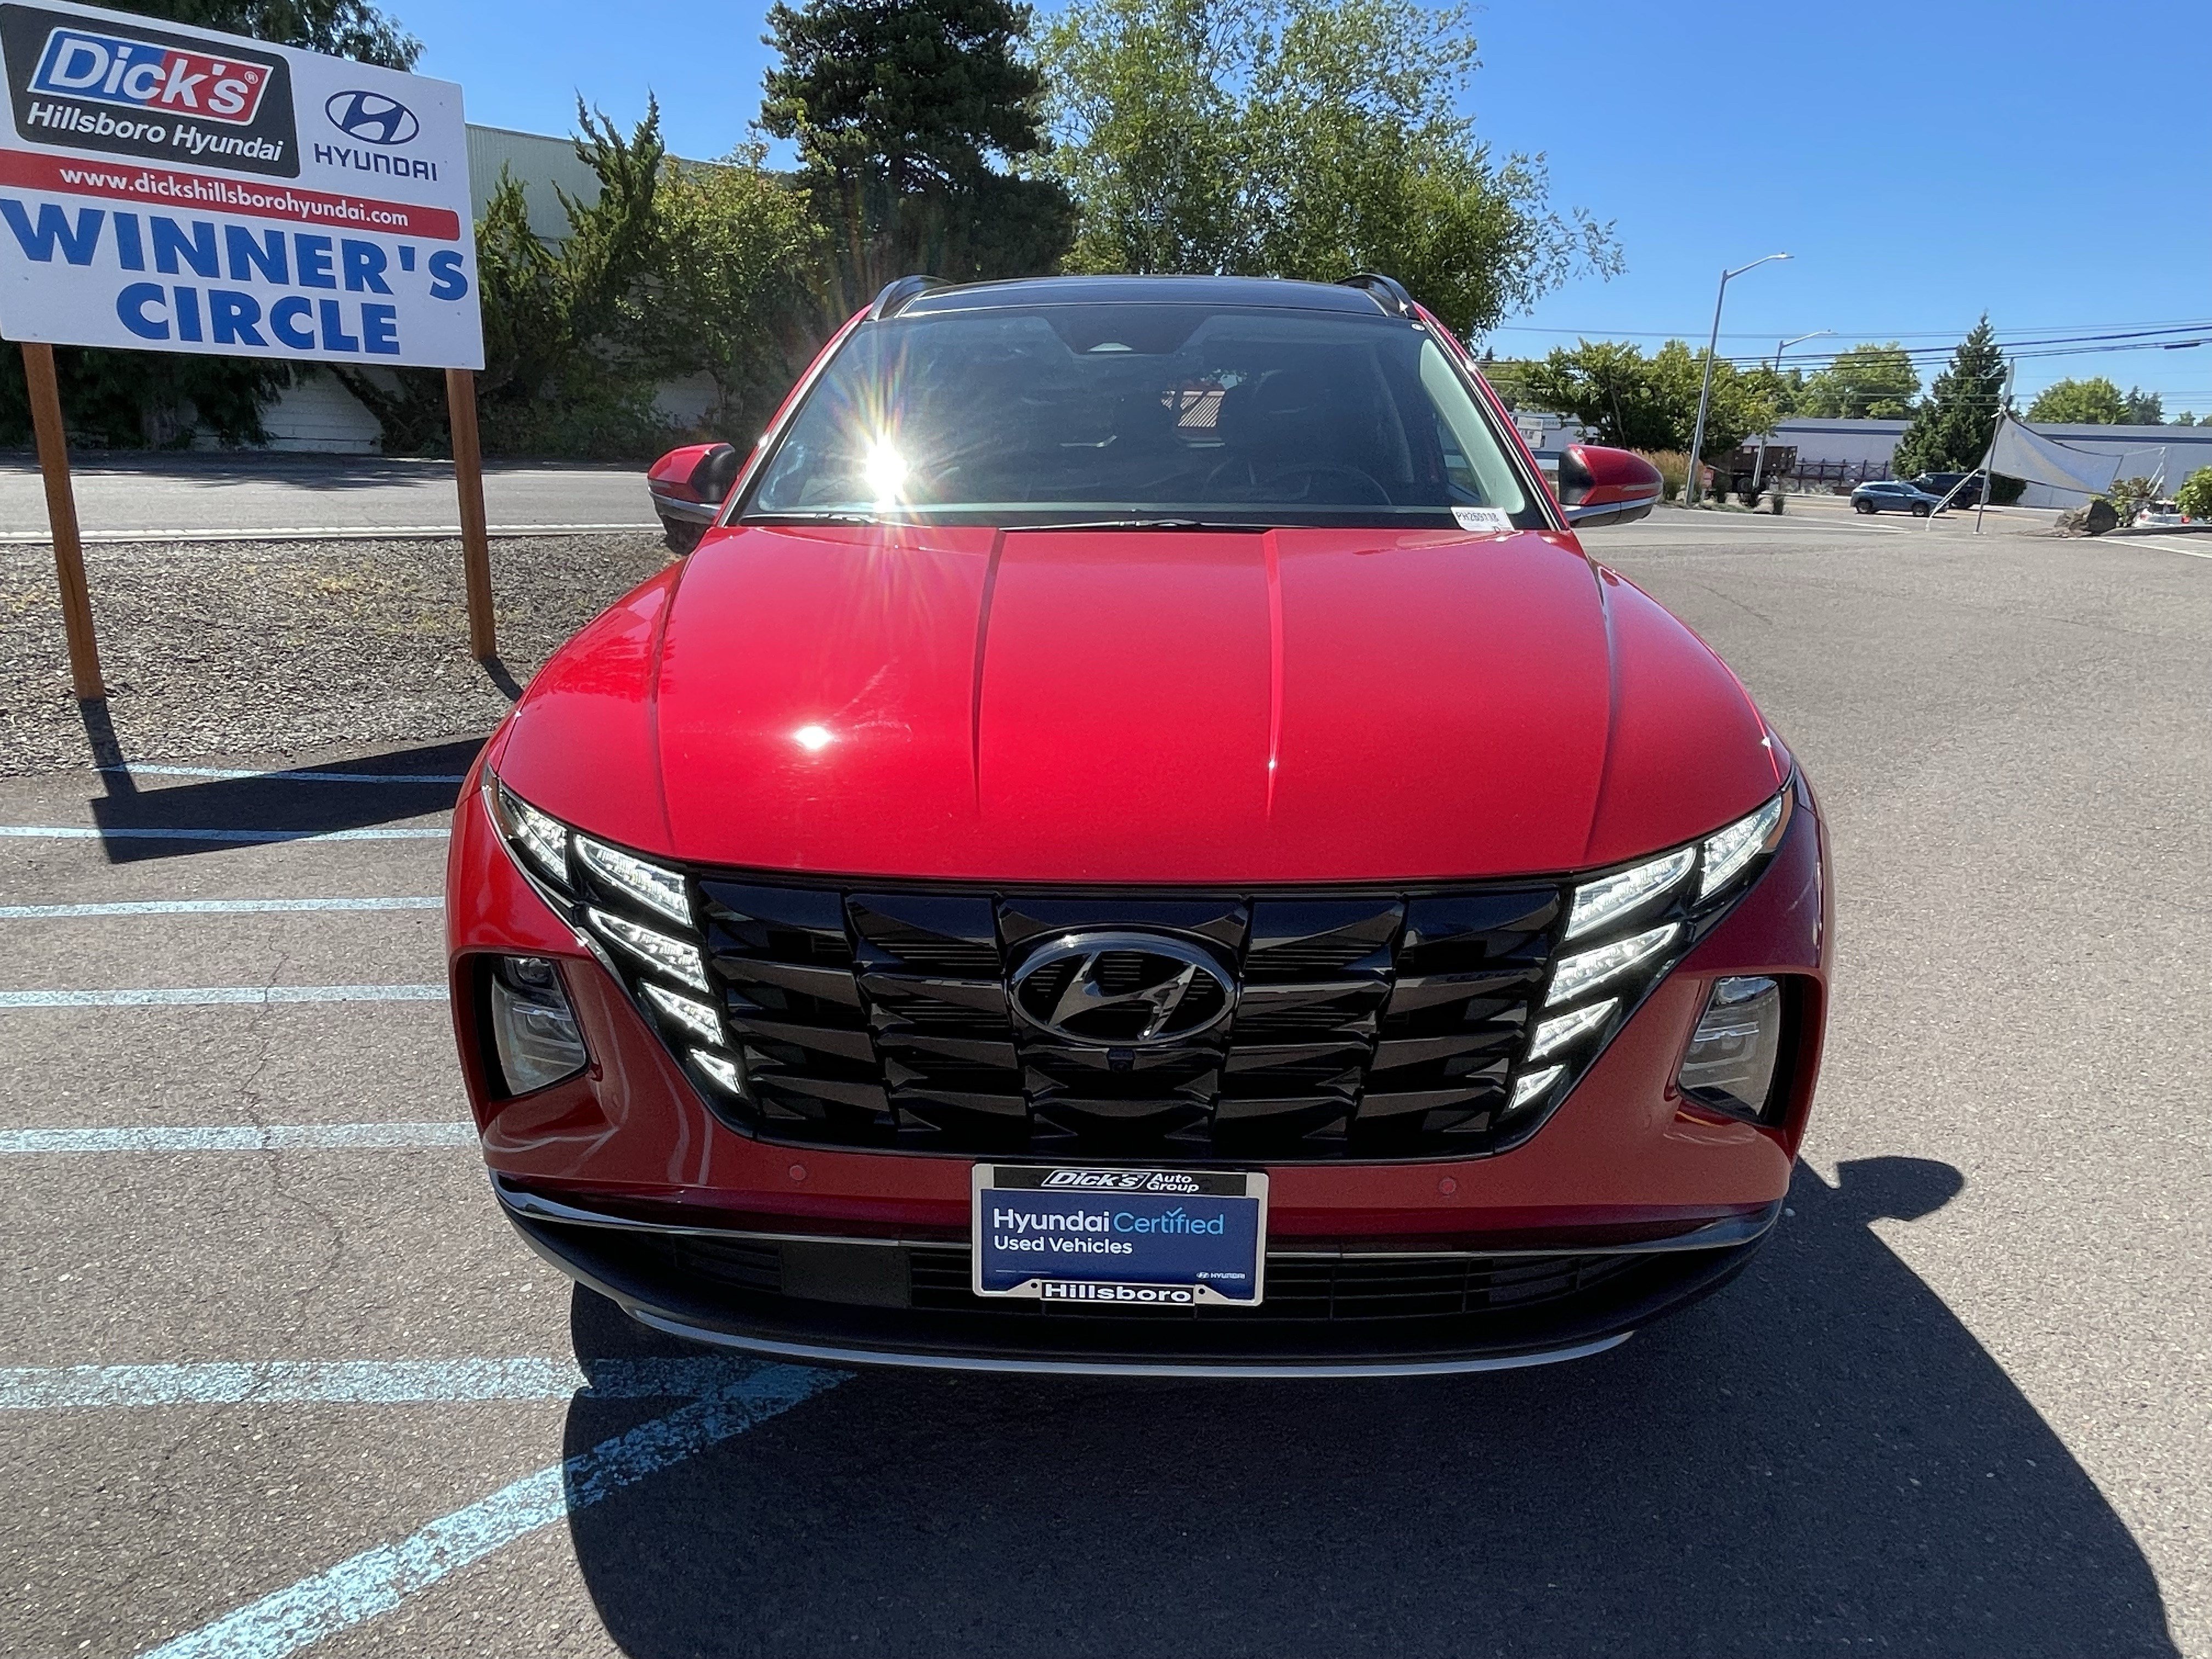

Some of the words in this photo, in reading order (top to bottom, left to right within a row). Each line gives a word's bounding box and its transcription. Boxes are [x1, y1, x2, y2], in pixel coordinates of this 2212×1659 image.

[48, 38, 249, 115] Dick's
[27, 102, 167, 144] Hillsboro
[172, 124, 284, 163] Hyundai
[314, 143, 437, 182] HYUNDAI
[60, 167, 408, 227] www.dickshillsborohyundai.com
[0, 199, 468, 300] WINNER'S
[116, 283, 400, 356] CIRCLE
[1049, 1172, 1138, 1187] Dick's
[1147, 1182, 1199, 1193] Group
[1152, 1173, 1192, 1183] Auto
[994, 1209, 1109, 1233] Hyundai
[1113, 1207, 1224, 1234] Certified
[994, 1236, 1045, 1251] Used
[1048, 1238, 1132, 1254] Vehicles
[1046, 1284, 1191, 1301] Hillsboro
